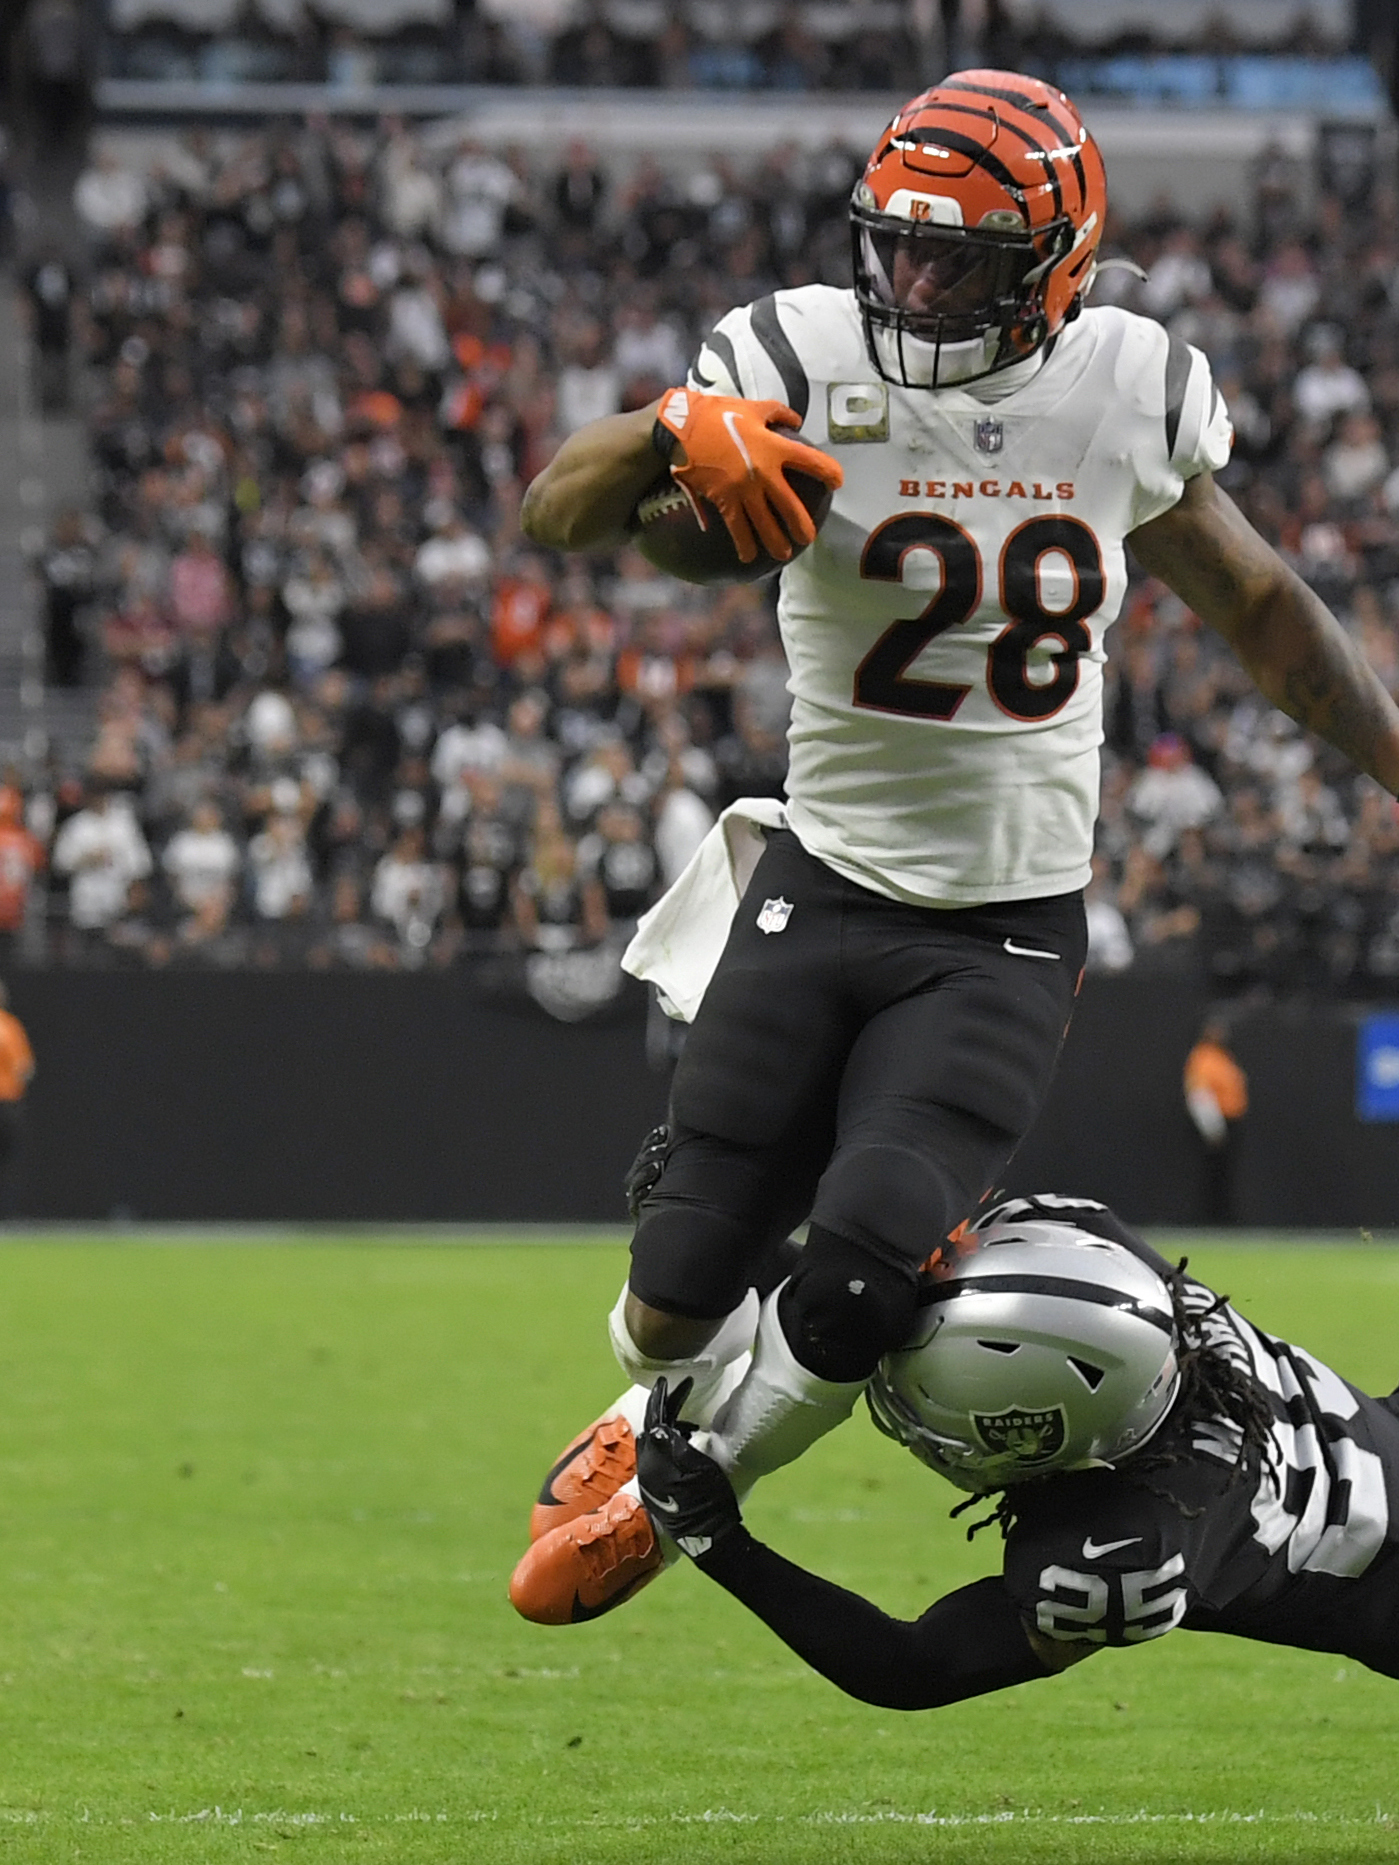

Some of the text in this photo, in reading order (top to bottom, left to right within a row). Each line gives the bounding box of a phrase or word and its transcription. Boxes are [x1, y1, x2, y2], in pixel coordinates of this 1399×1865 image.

[898, 479, 1075, 500] BENGALS
[851, 511, 1107, 722] 28
[982, 1413, 1055, 1428] RAIDERS
[1036, 1553, 1188, 1647] 25
